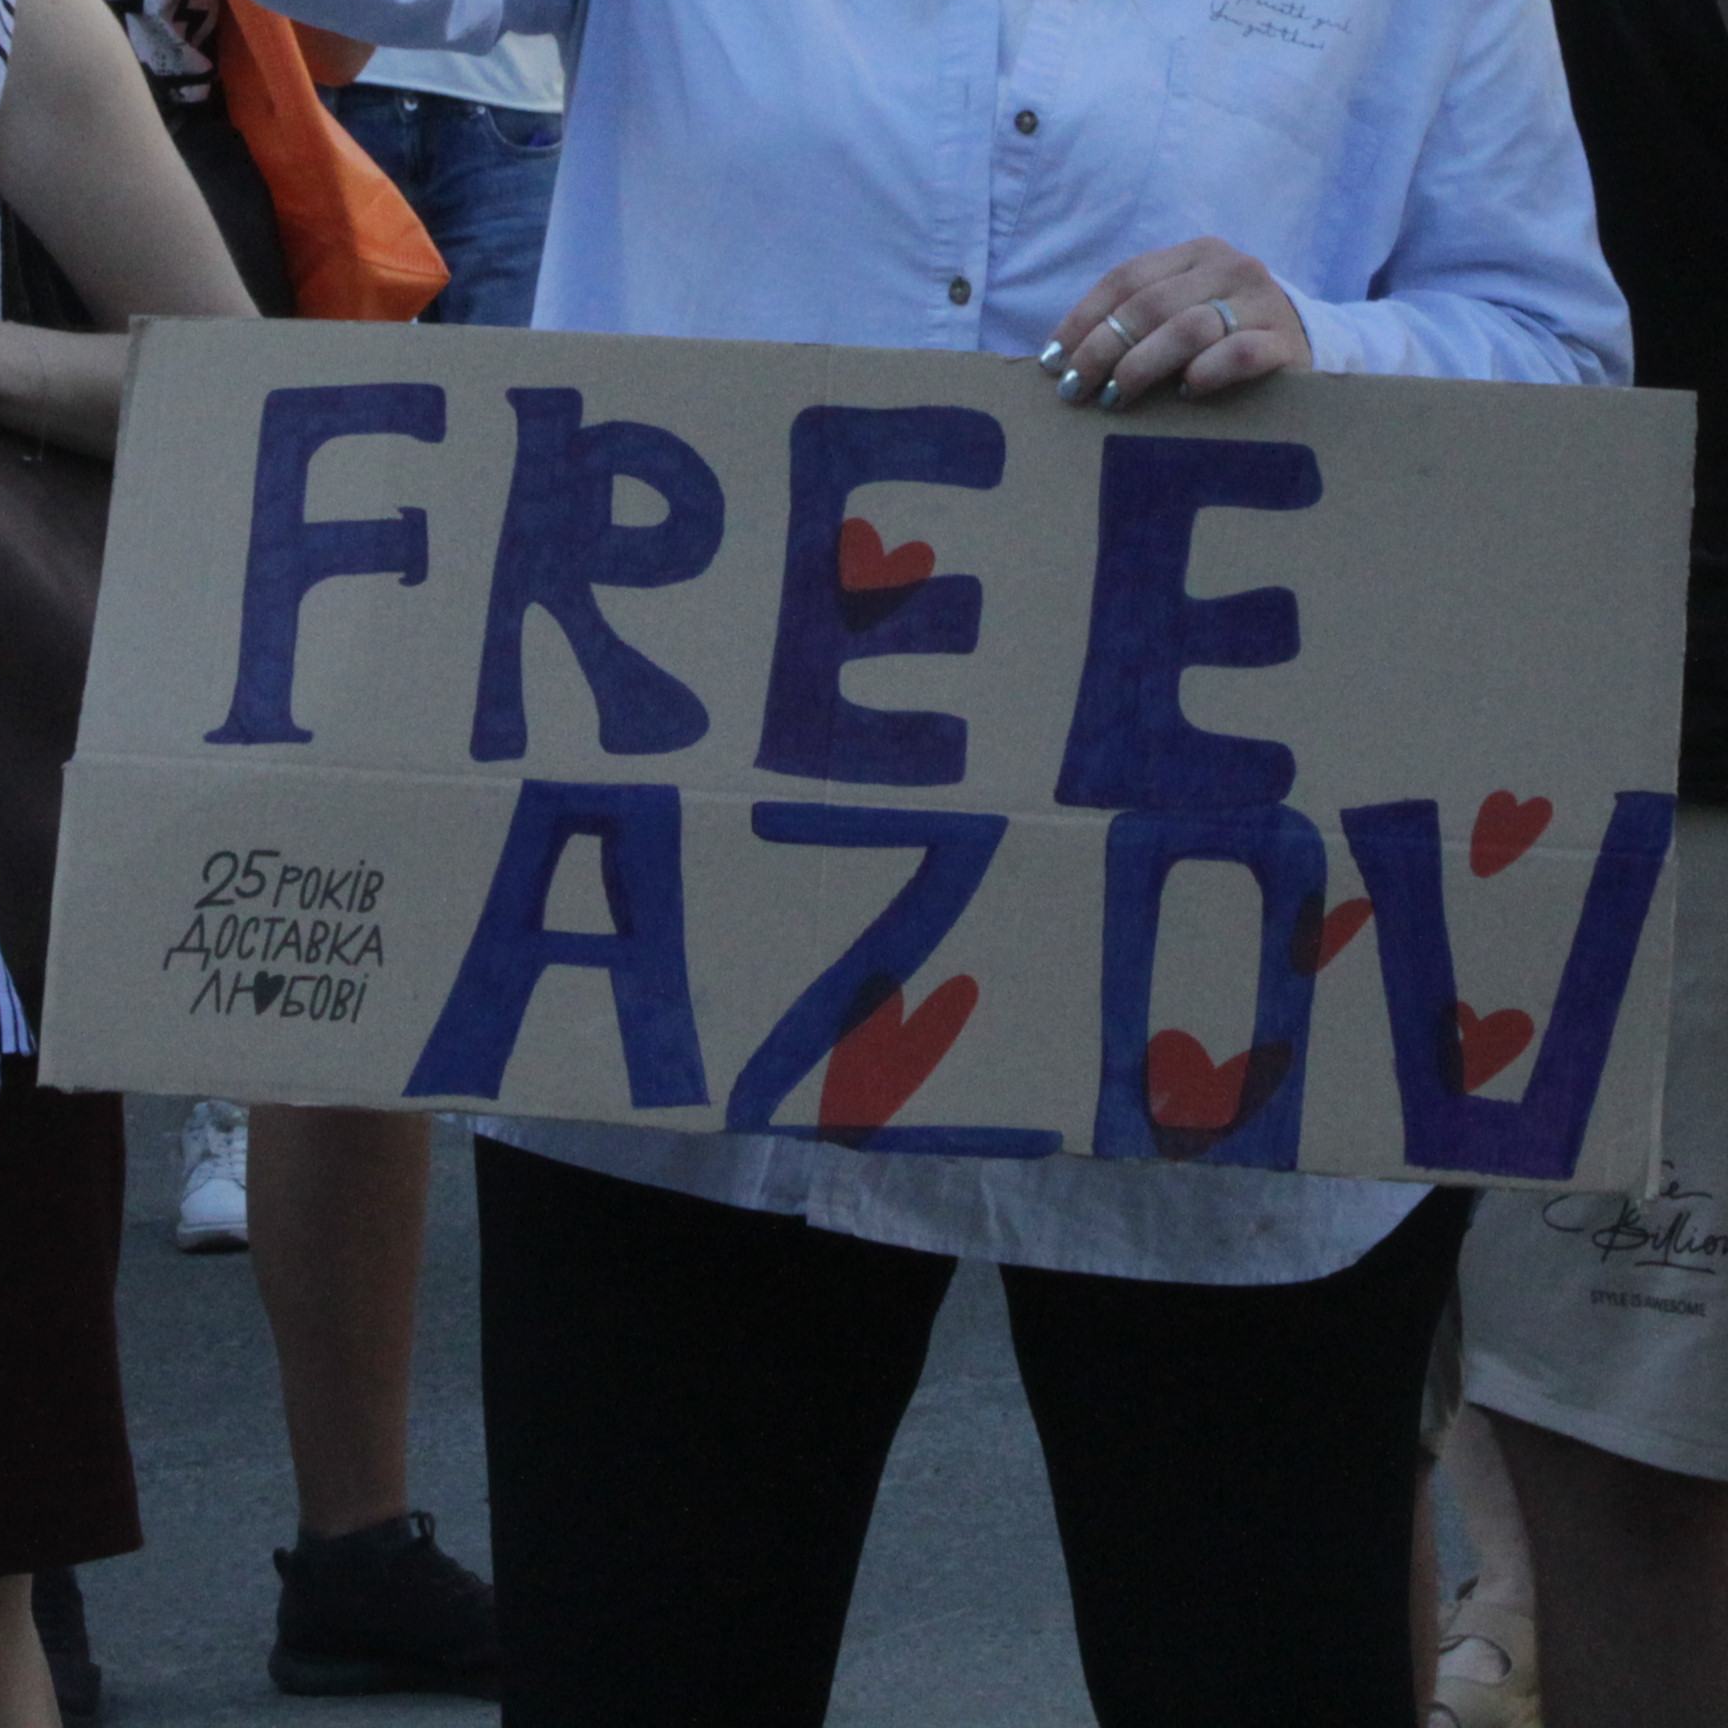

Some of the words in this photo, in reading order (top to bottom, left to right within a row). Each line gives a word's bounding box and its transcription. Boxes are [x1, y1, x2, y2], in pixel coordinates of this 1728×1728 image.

[204, 382, 1324, 810] FREE
[162, 912, 385, 972] ДОСТАВКА
[194, 849, 282, 909] 25
[272, 858, 385, 914] РОКІВ
[401, 777, 1677, 1179] AZOV
